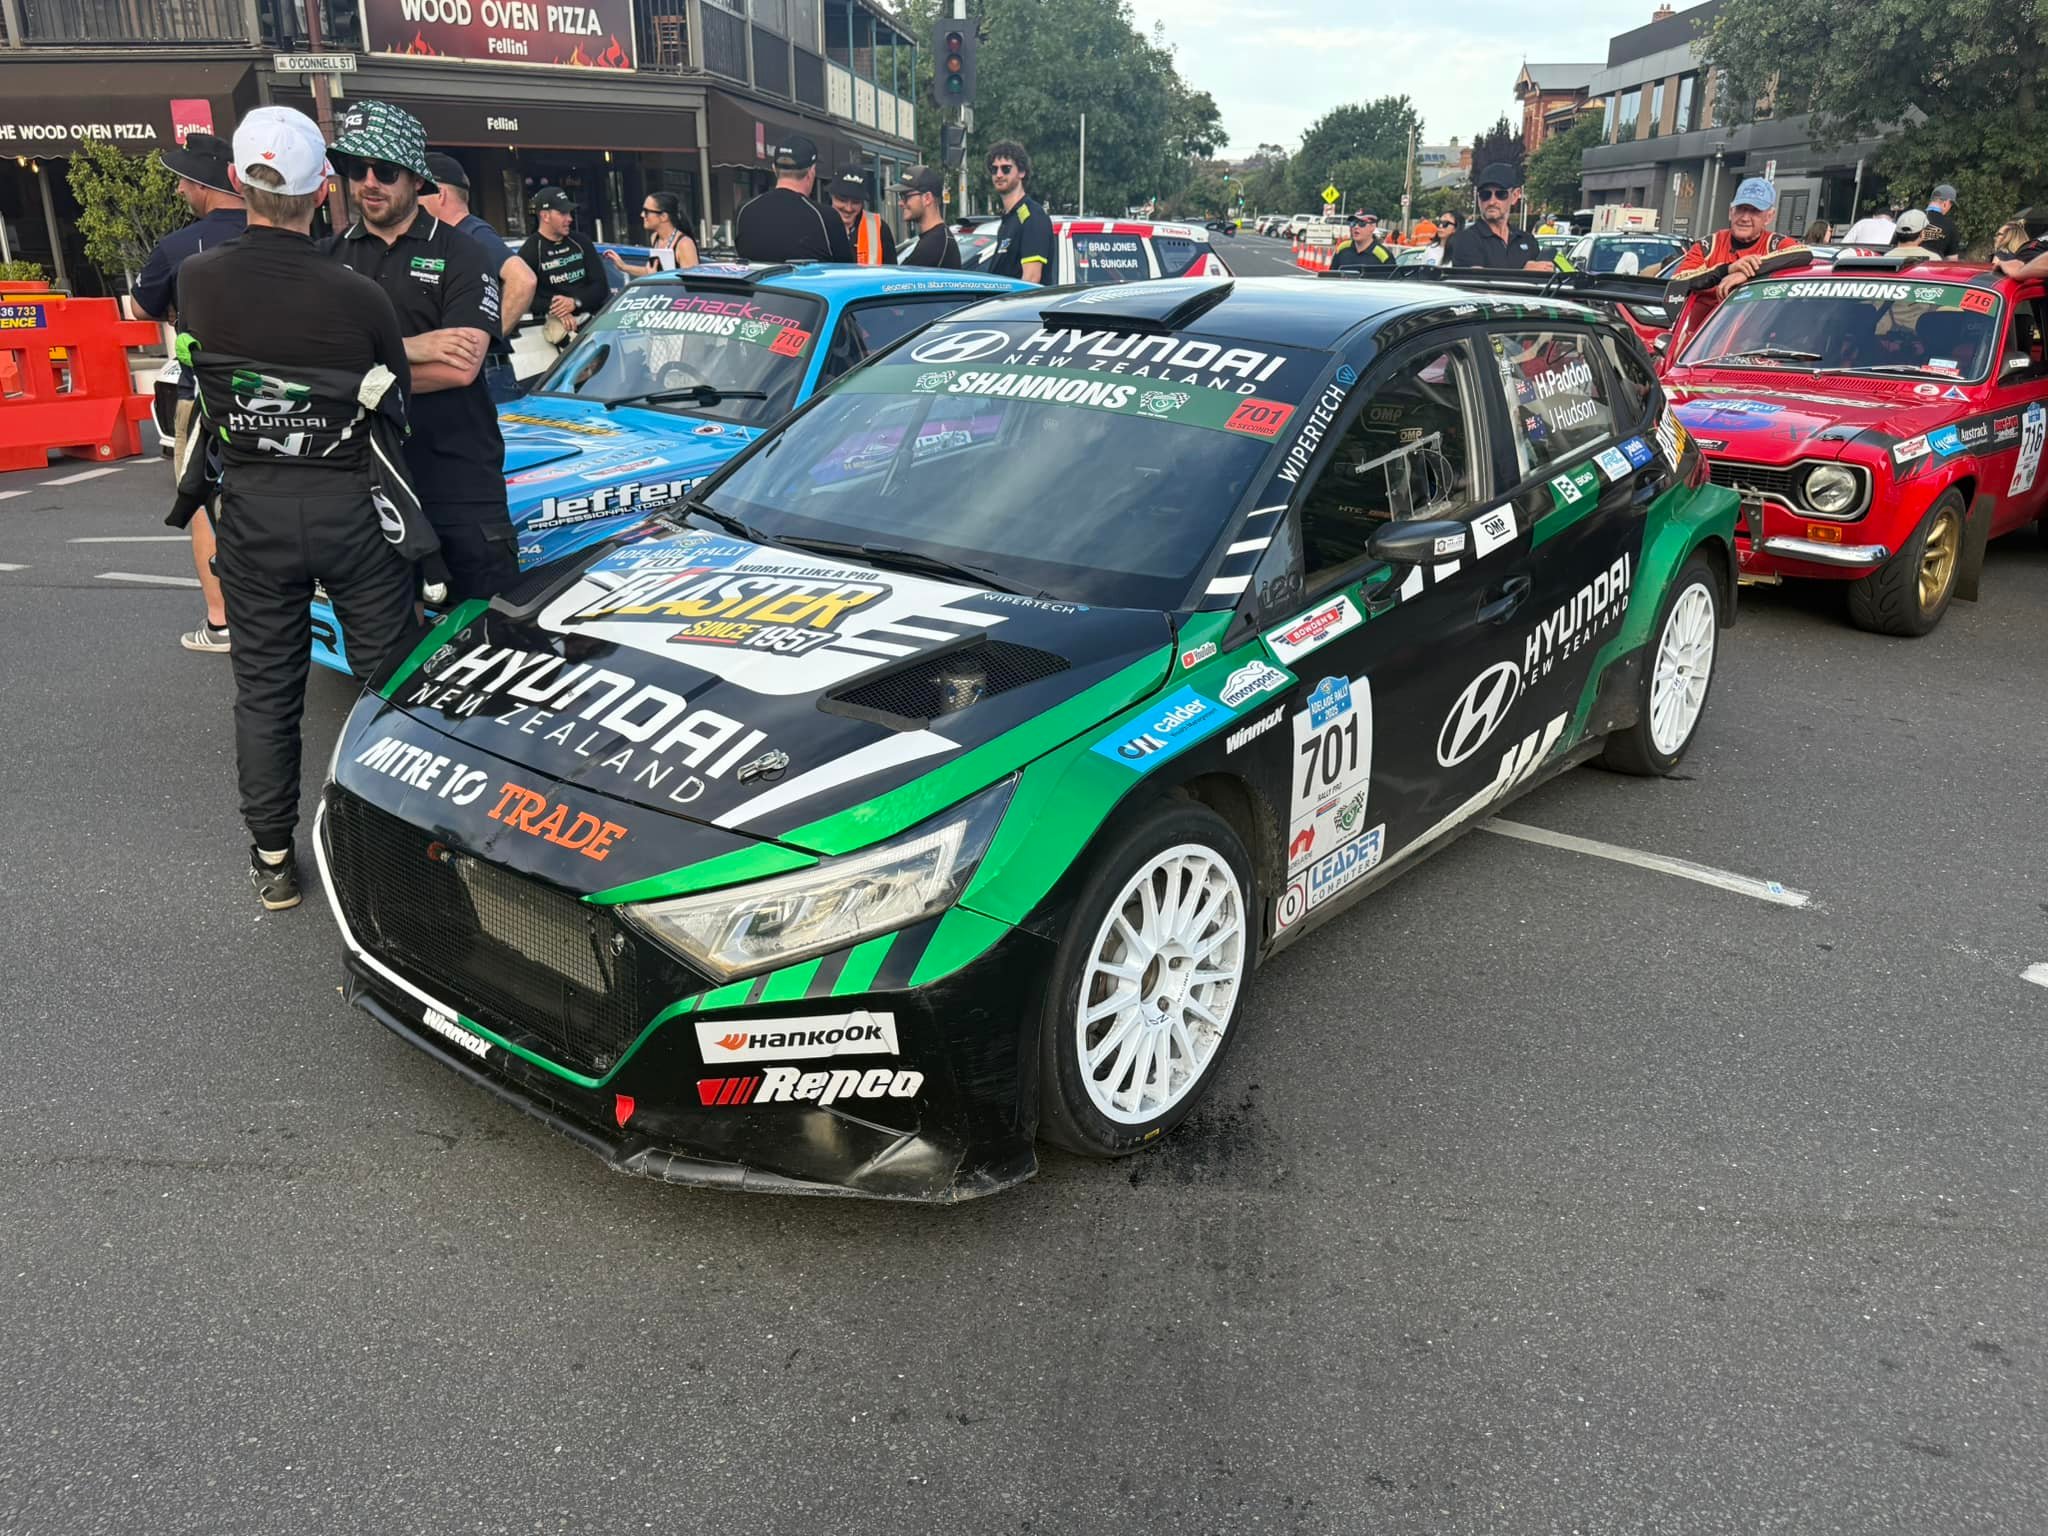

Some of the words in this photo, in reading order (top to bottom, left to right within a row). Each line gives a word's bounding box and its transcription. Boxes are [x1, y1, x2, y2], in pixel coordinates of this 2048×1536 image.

[401, 0, 473, 26] WOOD
[481, 1, 538, 31] OVEN
[548, 6, 603, 36] PIZZA
[487, 37, 529, 57] Fellini
[288, 56, 338, 70] O'CONNELL
[340, 57, 351, 69] ST
[19, 125, 67, 140] WOOD
[70, 124, 112, 140] OVEN
[114, 124, 157, 139] PIZZA
[486, 116, 518, 131] Fellini
[1089, 241, 1110, 251] BRAD
[1111, 241, 1137, 251] JONES
[1091, 259, 1099, 268] R.
[1100, 258, 1138, 268] SUNGKAR
[1787, 283, 1911, 300] SHANNONS
[1963, 293, 1991, 308] 716
[17, 306, 36, 317] 733
[637, 310, 740, 336] SHANNONS
[776, 332, 806, 349] 710
[1017, 328, 1288, 382] HYUNDAI
[1002, 353, 1072, 369] NEW
[1087, 359, 1257, 396] ZEALAND
[948, 371, 1137, 409] SHANNONS
[228, 413, 327, 427] HYUNDAI
[1235, 404, 1284, 425] 701
[1554, 399, 1598, 430] Hudson
[1277, 384, 1346, 483] WIPERTECH
[1400, 430, 1422, 440] OMP
[2022, 423, 2043, 456] 716
[528, 505, 633, 531] PROFESSIONAL
[634, 497, 677, 512] TOOLS
[1485, 518, 1506, 536] OMP
[608, 549, 691, 561] ADELAIDE
[691, 546, 749, 557] RALLY
[735, 564, 782, 574] WORK
[782, 566, 799, 574] IT
[800, 567, 831, 577] LIKE
[832, 570, 844, 578] A
[846, 572, 880, 581] PRO
[574, 570, 885, 629] BLASTER
[984, 593, 1075, 614] WIPERTECH
[1523, 552, 1630, 675] HYUNDAI
[682, 620, 762, 640] SINCE
[743, 625, 836, 652] 1957
[1293, 612, 1335, 640] BOWDEN'S
[1226, 669, 1280, 705] motorsport
[1311, 692, 1334, 714] ADELAIDE
[1334, 685, 1348, 699] RALLY
[436, 643, 768, 780] HYUNDAI
[1153, 699, 1207, 733] calder
[407, 683, 492, 717] NEW
[495, 702, 706, 803] ZEALAND
[1301, 712, 1358, 799] 701
[355, 737, 450, 791] MITRE
[437, 764, 488, 806] 10
[488, 782, 628, 862] TRADE
[1312, 830, 1380, 891] LEADER
[1311, 854, 1378, 905] COMPUTERS
[753, 1066, 925, 1107] Repco
